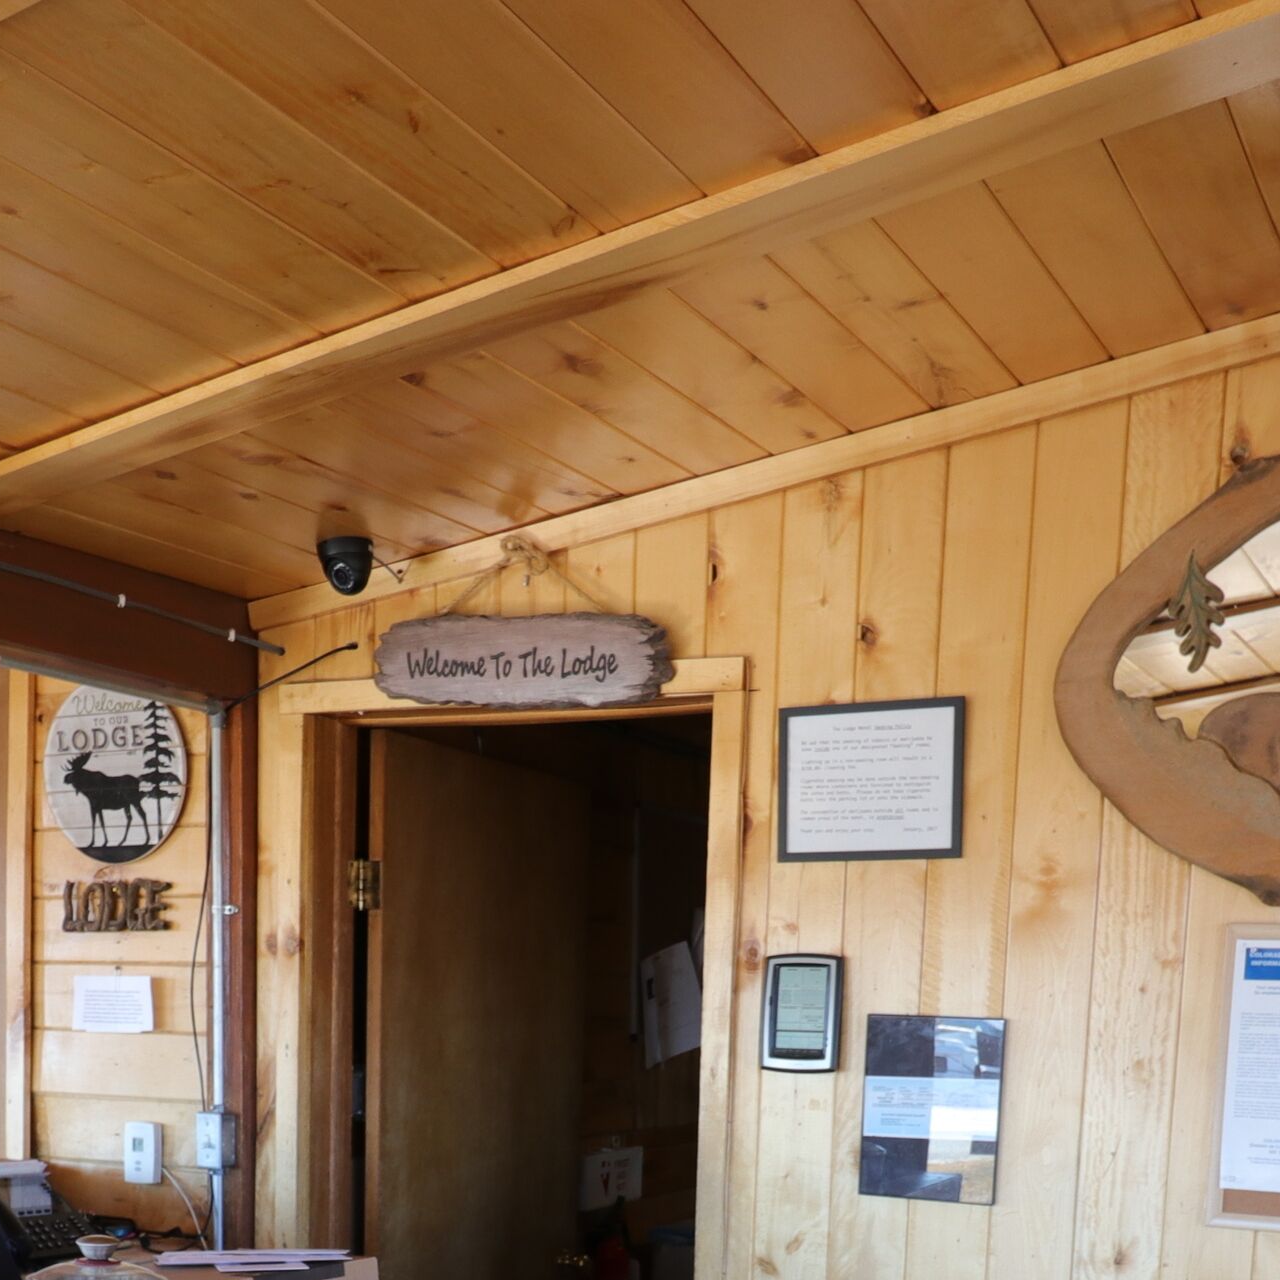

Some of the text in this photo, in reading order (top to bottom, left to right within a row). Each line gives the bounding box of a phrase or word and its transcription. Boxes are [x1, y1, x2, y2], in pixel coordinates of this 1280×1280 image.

[407, 646, 618, 682] Welcome To The Lodge
[72, 694, 143, 714] Welcome
[94, 716, 128, 726] TO OUR
[57, 725, 143, 752] LODGE
[63, 878, 173, 932] LODGE
